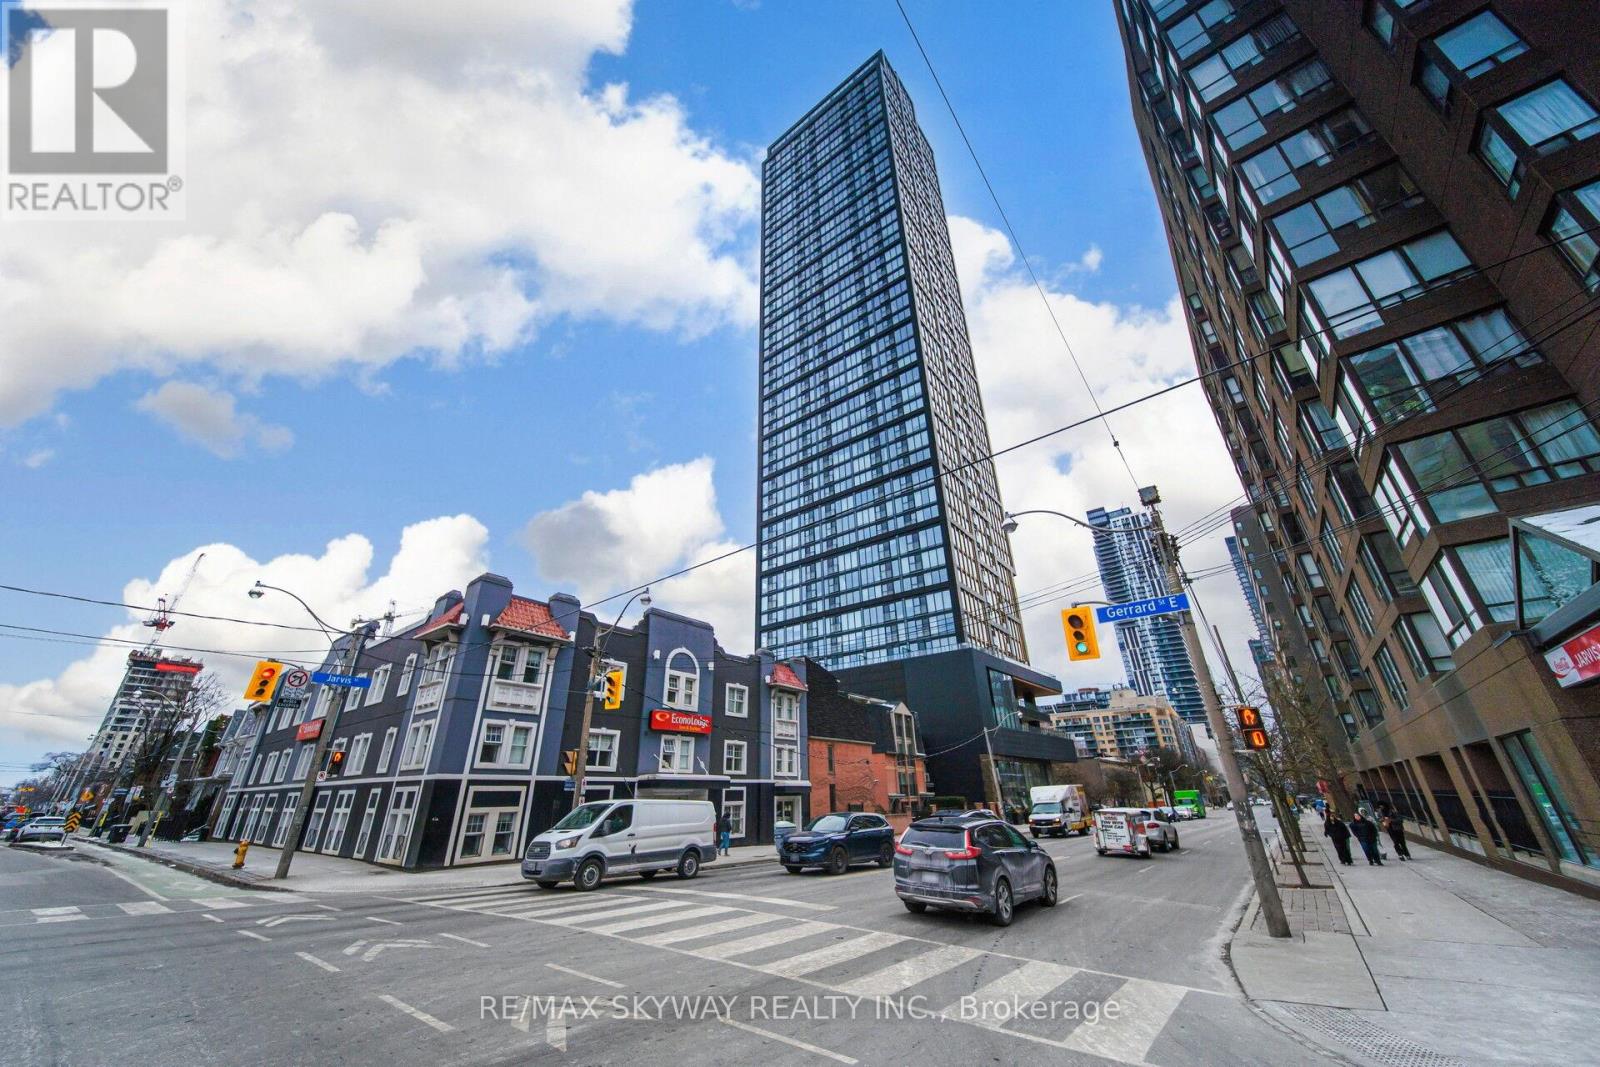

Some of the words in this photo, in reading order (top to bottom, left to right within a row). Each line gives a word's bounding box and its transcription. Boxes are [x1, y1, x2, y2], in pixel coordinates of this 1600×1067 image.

[1106, 601, 1156, 618] Gerrard
[1168, 596, 1178, 608] E
[326, 674, 352, 684] Jarvis
